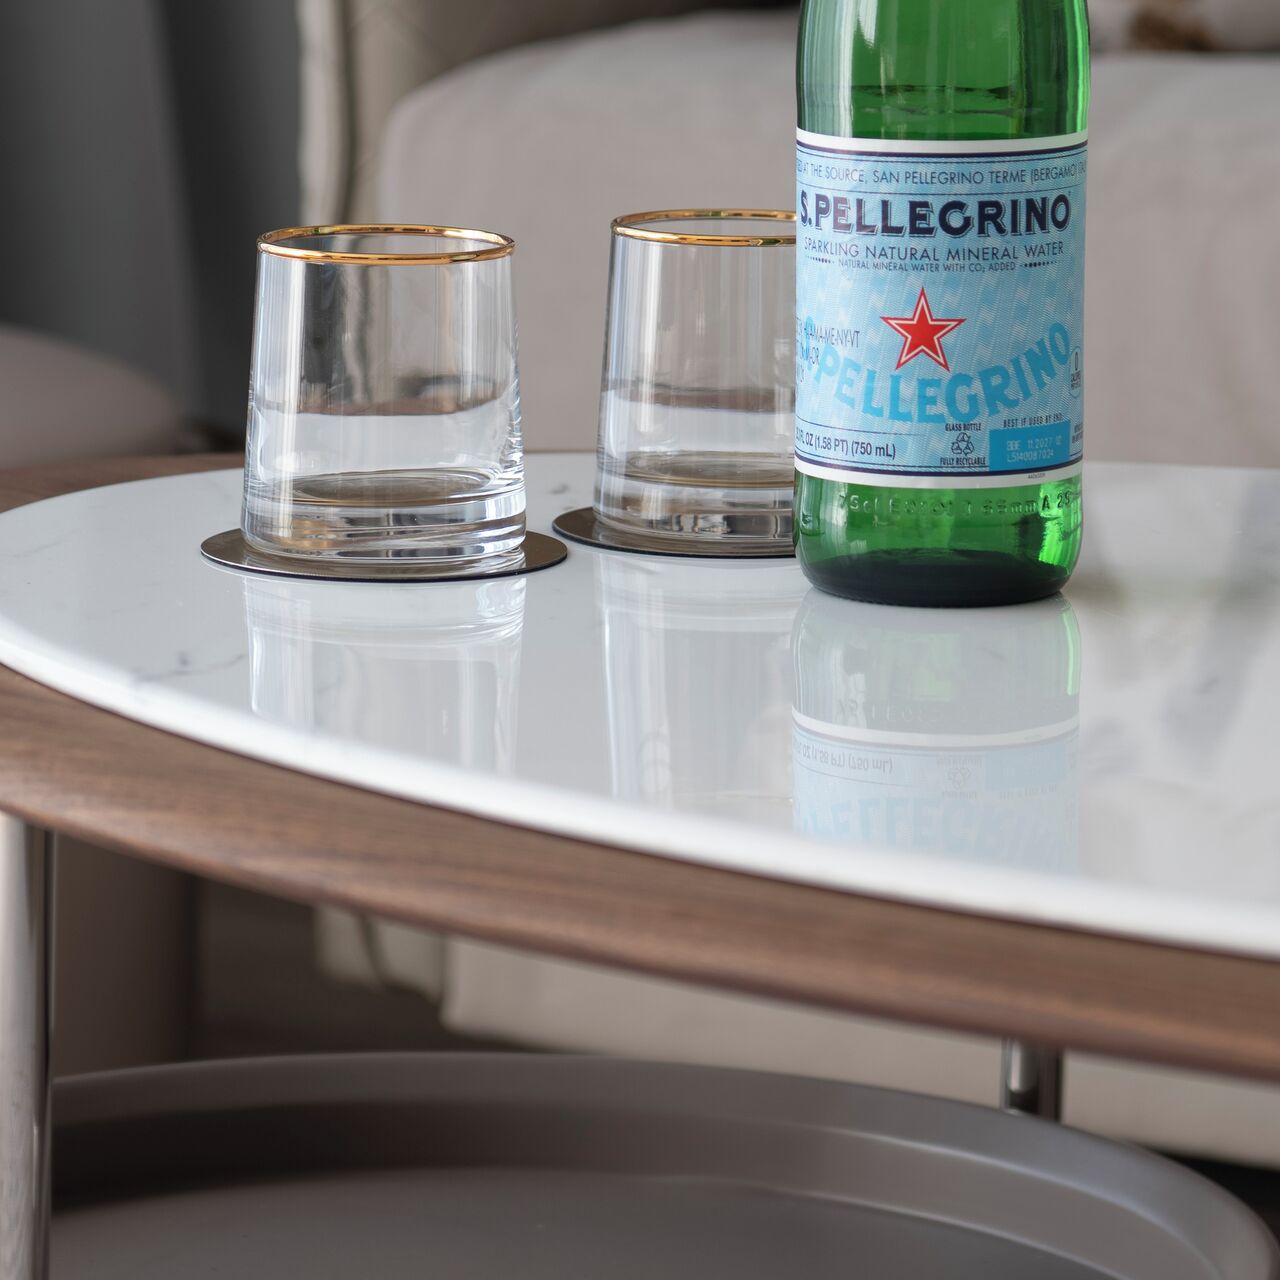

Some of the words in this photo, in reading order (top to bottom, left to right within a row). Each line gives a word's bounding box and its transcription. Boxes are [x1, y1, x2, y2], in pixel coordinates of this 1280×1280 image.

[810, 163, 823, 178] THE
[825, 166, 869, 184] SOURCE,
[872, 169, 900, 184] SAN
[904, 170, 985, 185] PELLEGRINO
[988, 169, 1027, 183] TERME
[800, 189, 1072, 238] S.PELLEGRINO
[804, 236, 860, 258] SPARKLING
[865, 245, 940, 262] NATURAL
[946, 245, 1019, 261] MINERAL
[1024, 241, 1064, 258] WATER
[838, 259, 869, 270] NATURAL
[872, 261, 908, 272] MINERAL
[911, 263, 940, 273] WATER
[943, 263, 966, 273] WITH
[988, 261, 1016, 272] ADDED
[945, 423, 962, 432] GLASS
[963, 422, 981, 431] BOTTLE
[1004, 417, 1018, 428] BEST
[805, 432, 814, 447] OZ
[815, 434, 832, 450] (1.58
[834, 438, 849, 456] PT)
[851, 440, 872, 457] (750
[875, 443, 896, 460] mL)
[939, 457, 954, 466] FULLY
[956, 456, 986, 466] RECYCLABLE
